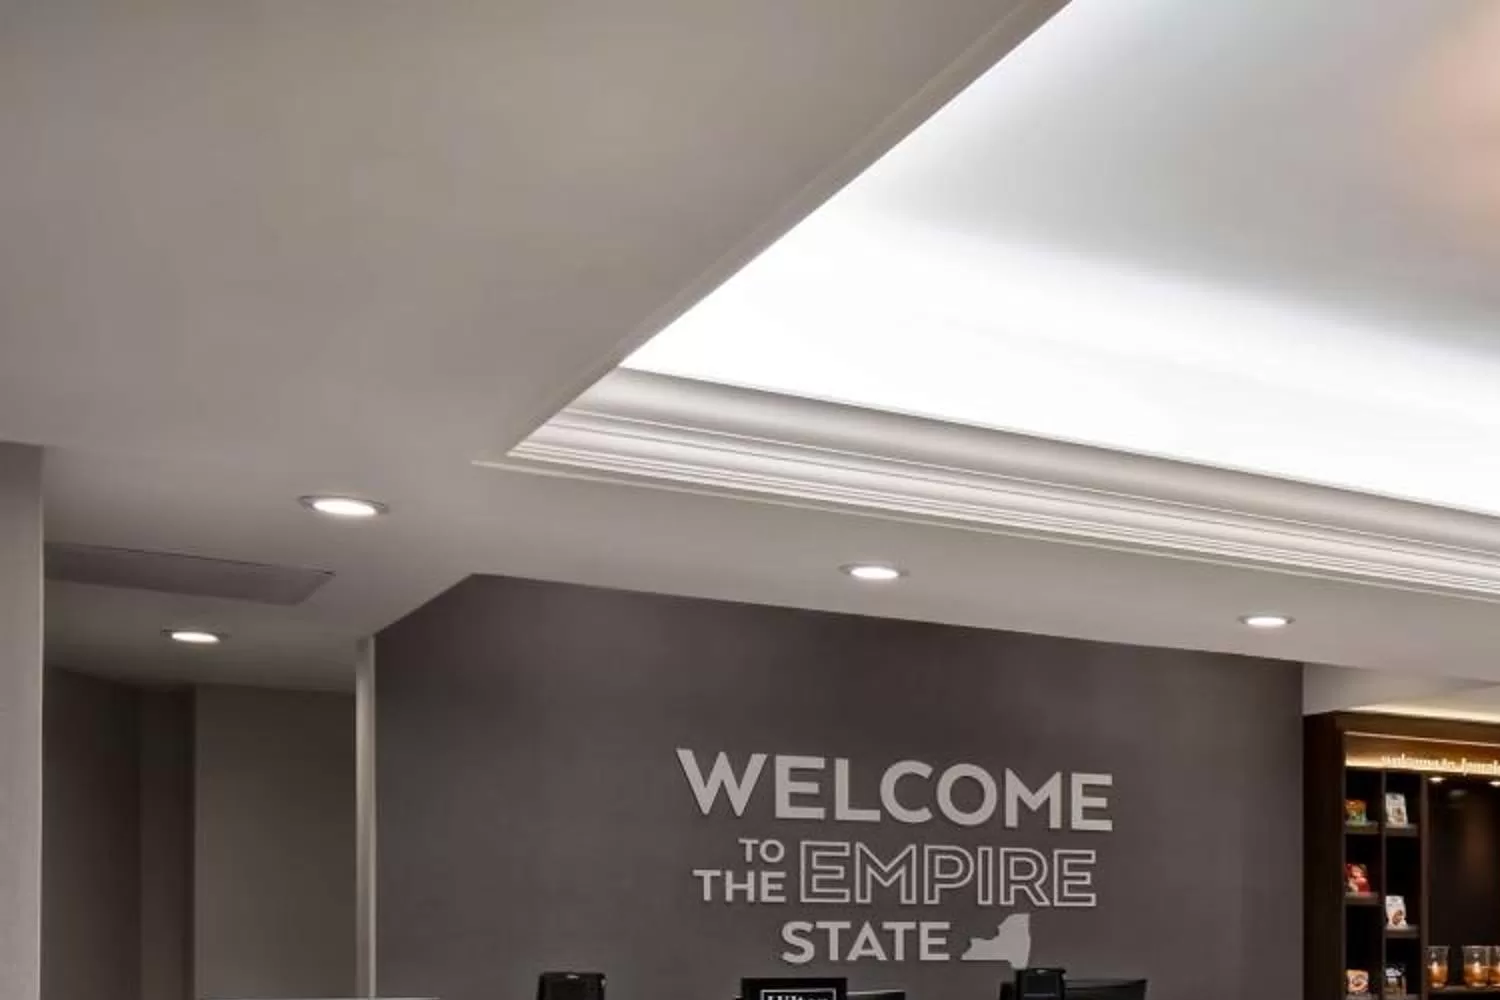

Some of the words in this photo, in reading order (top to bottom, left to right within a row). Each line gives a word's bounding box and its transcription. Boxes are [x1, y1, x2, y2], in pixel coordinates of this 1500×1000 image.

[676, 748, 1113, 831] WELCOME
[693, 869, 786, 902] THE
[800, 840, 1097, 907] EMPIRE
[738, 838, 785, 864] TO
[781, 921, 951, 964] STATE
